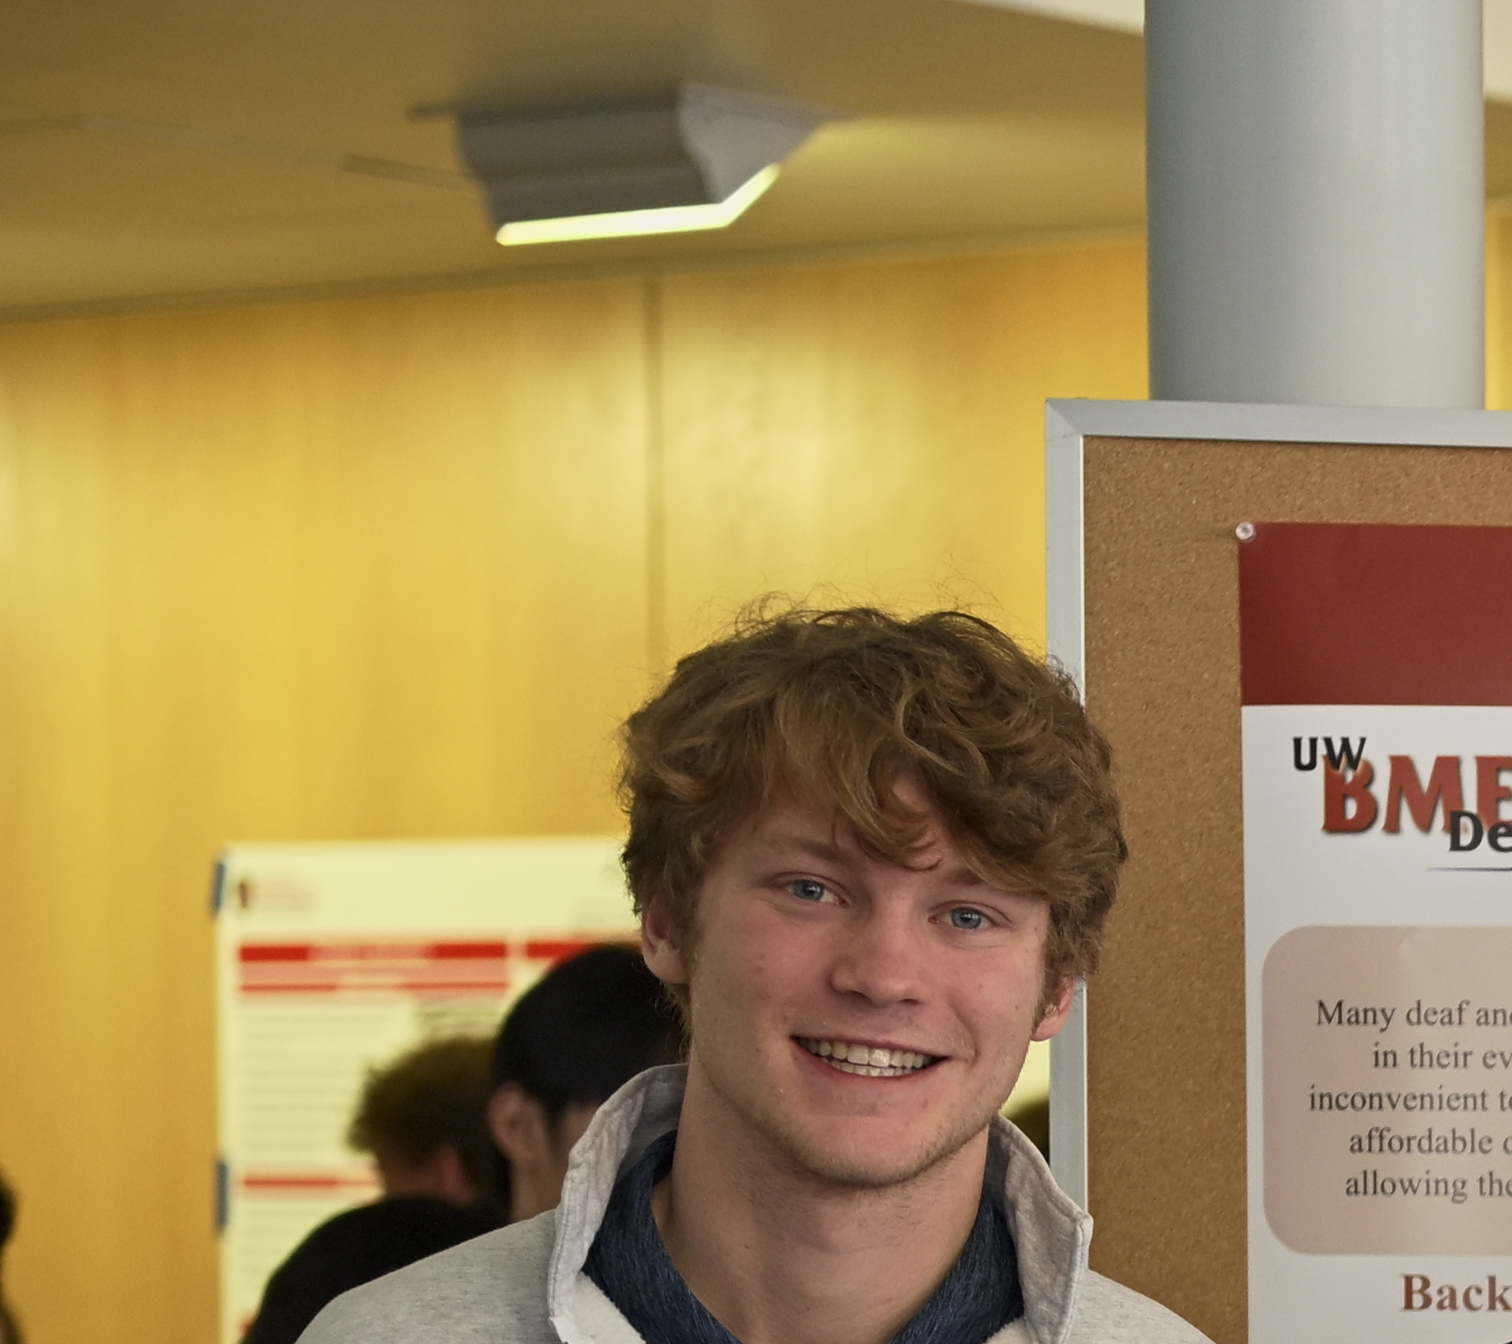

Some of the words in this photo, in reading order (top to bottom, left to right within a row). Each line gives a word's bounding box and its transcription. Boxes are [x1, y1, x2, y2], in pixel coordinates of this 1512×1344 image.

[1292, 735, 1367, 773] UW
[1316, 999, 1396, 1034] Many
[1405, 999, 1471, 1027] deaf
[1407, 1041, 1474, 1070] their
[1307, 1082, 1488, 1113] inconvenient
[1348, 1125, 1493, 1156] affordable
[1344, 1167, 1468, 1204] allowing
